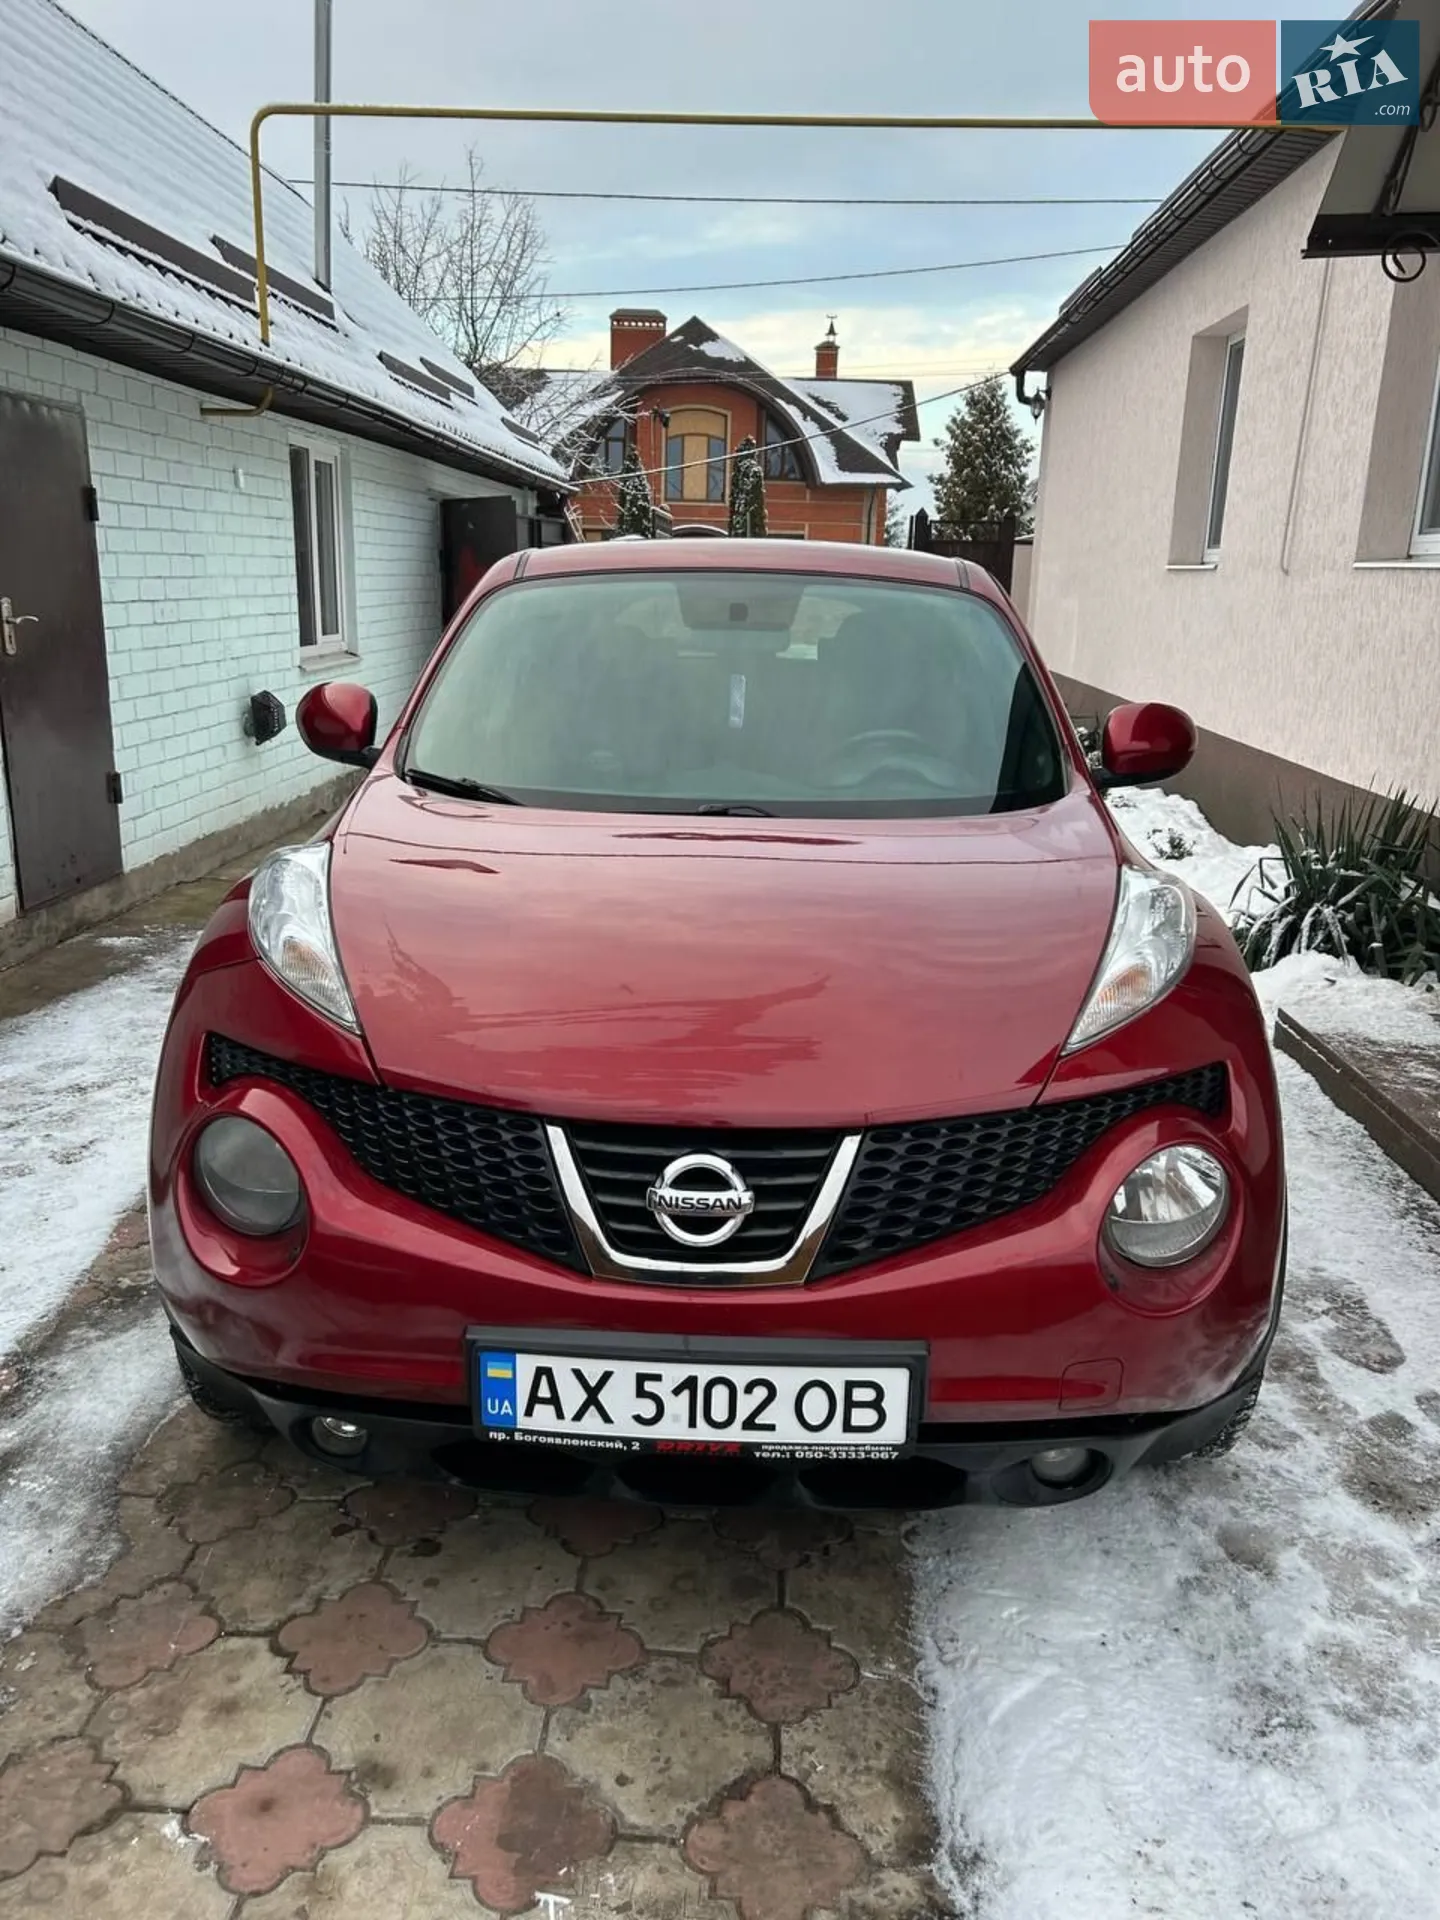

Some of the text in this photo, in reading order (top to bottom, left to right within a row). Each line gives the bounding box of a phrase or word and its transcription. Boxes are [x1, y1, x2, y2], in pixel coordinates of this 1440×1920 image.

[657, 1194, 742, 1212] NISSAN
[487, 1397, 513, 1416] UA
[523, 1365, 888, 1434] AX 5102 OB
[488, 1431, 641, 1451] пр. Богоявленский, 2
[795, 1451, 900, 1459] 050-3333-067
